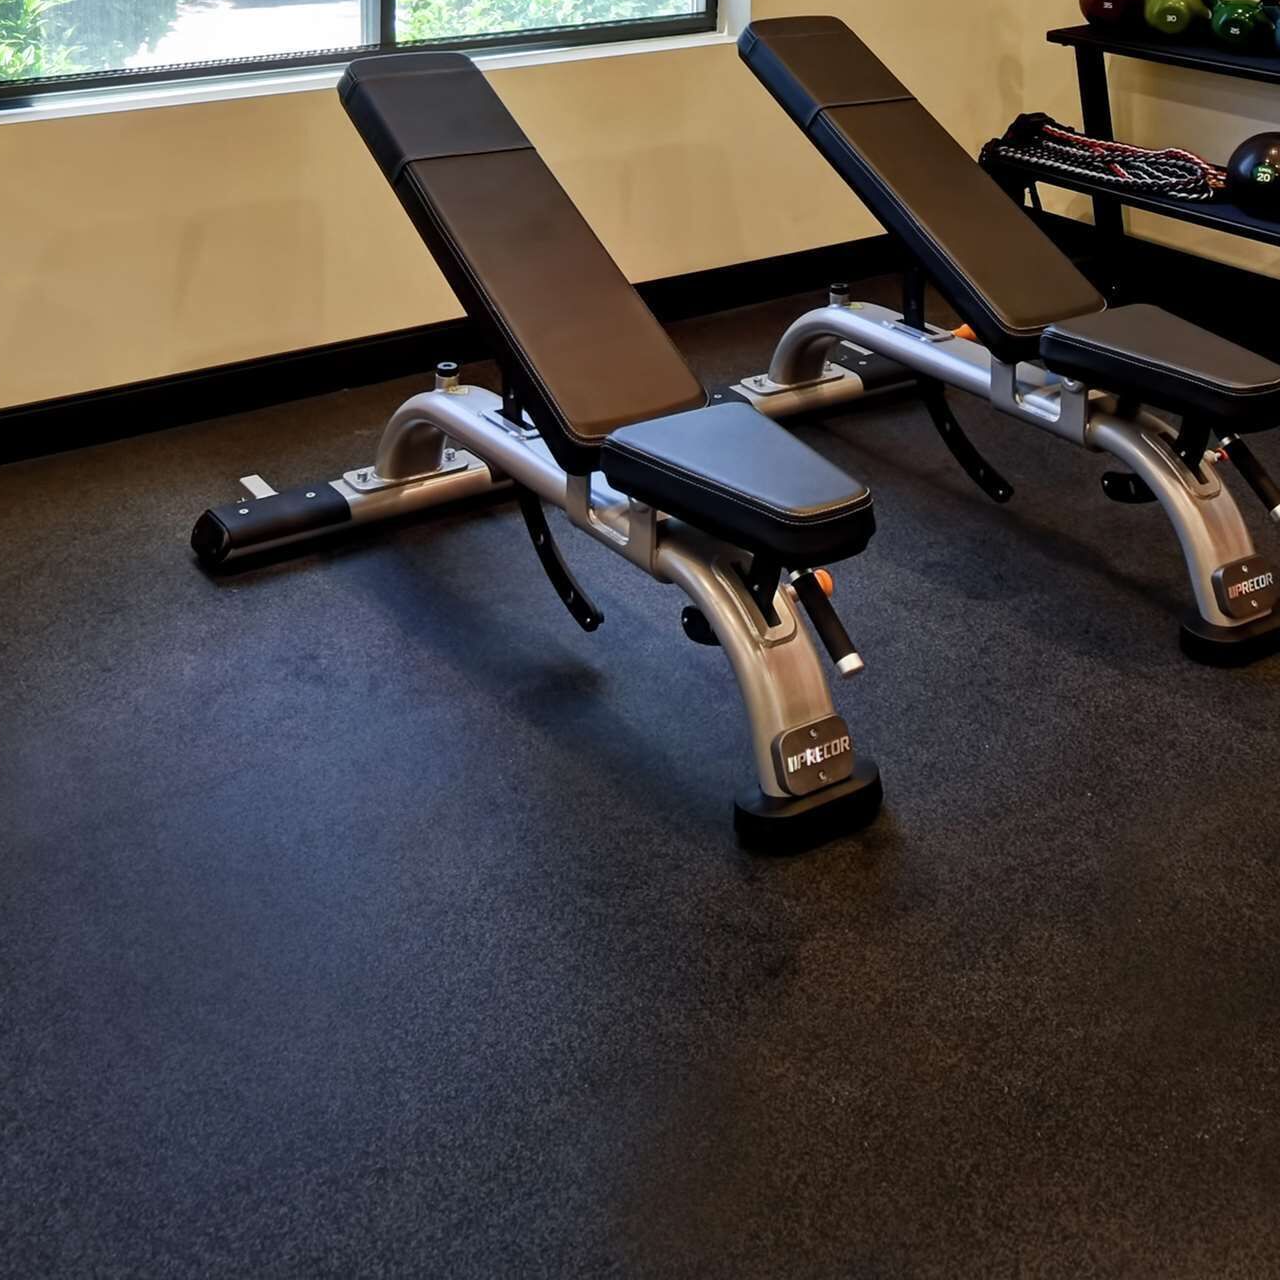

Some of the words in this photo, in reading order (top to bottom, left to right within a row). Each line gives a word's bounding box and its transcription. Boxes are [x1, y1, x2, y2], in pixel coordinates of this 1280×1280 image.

[1256, 172, 1271, 182] 20
[1236, 572, 1273, 598] PRECOR
[797, 735, 851, 768] PRECOR
